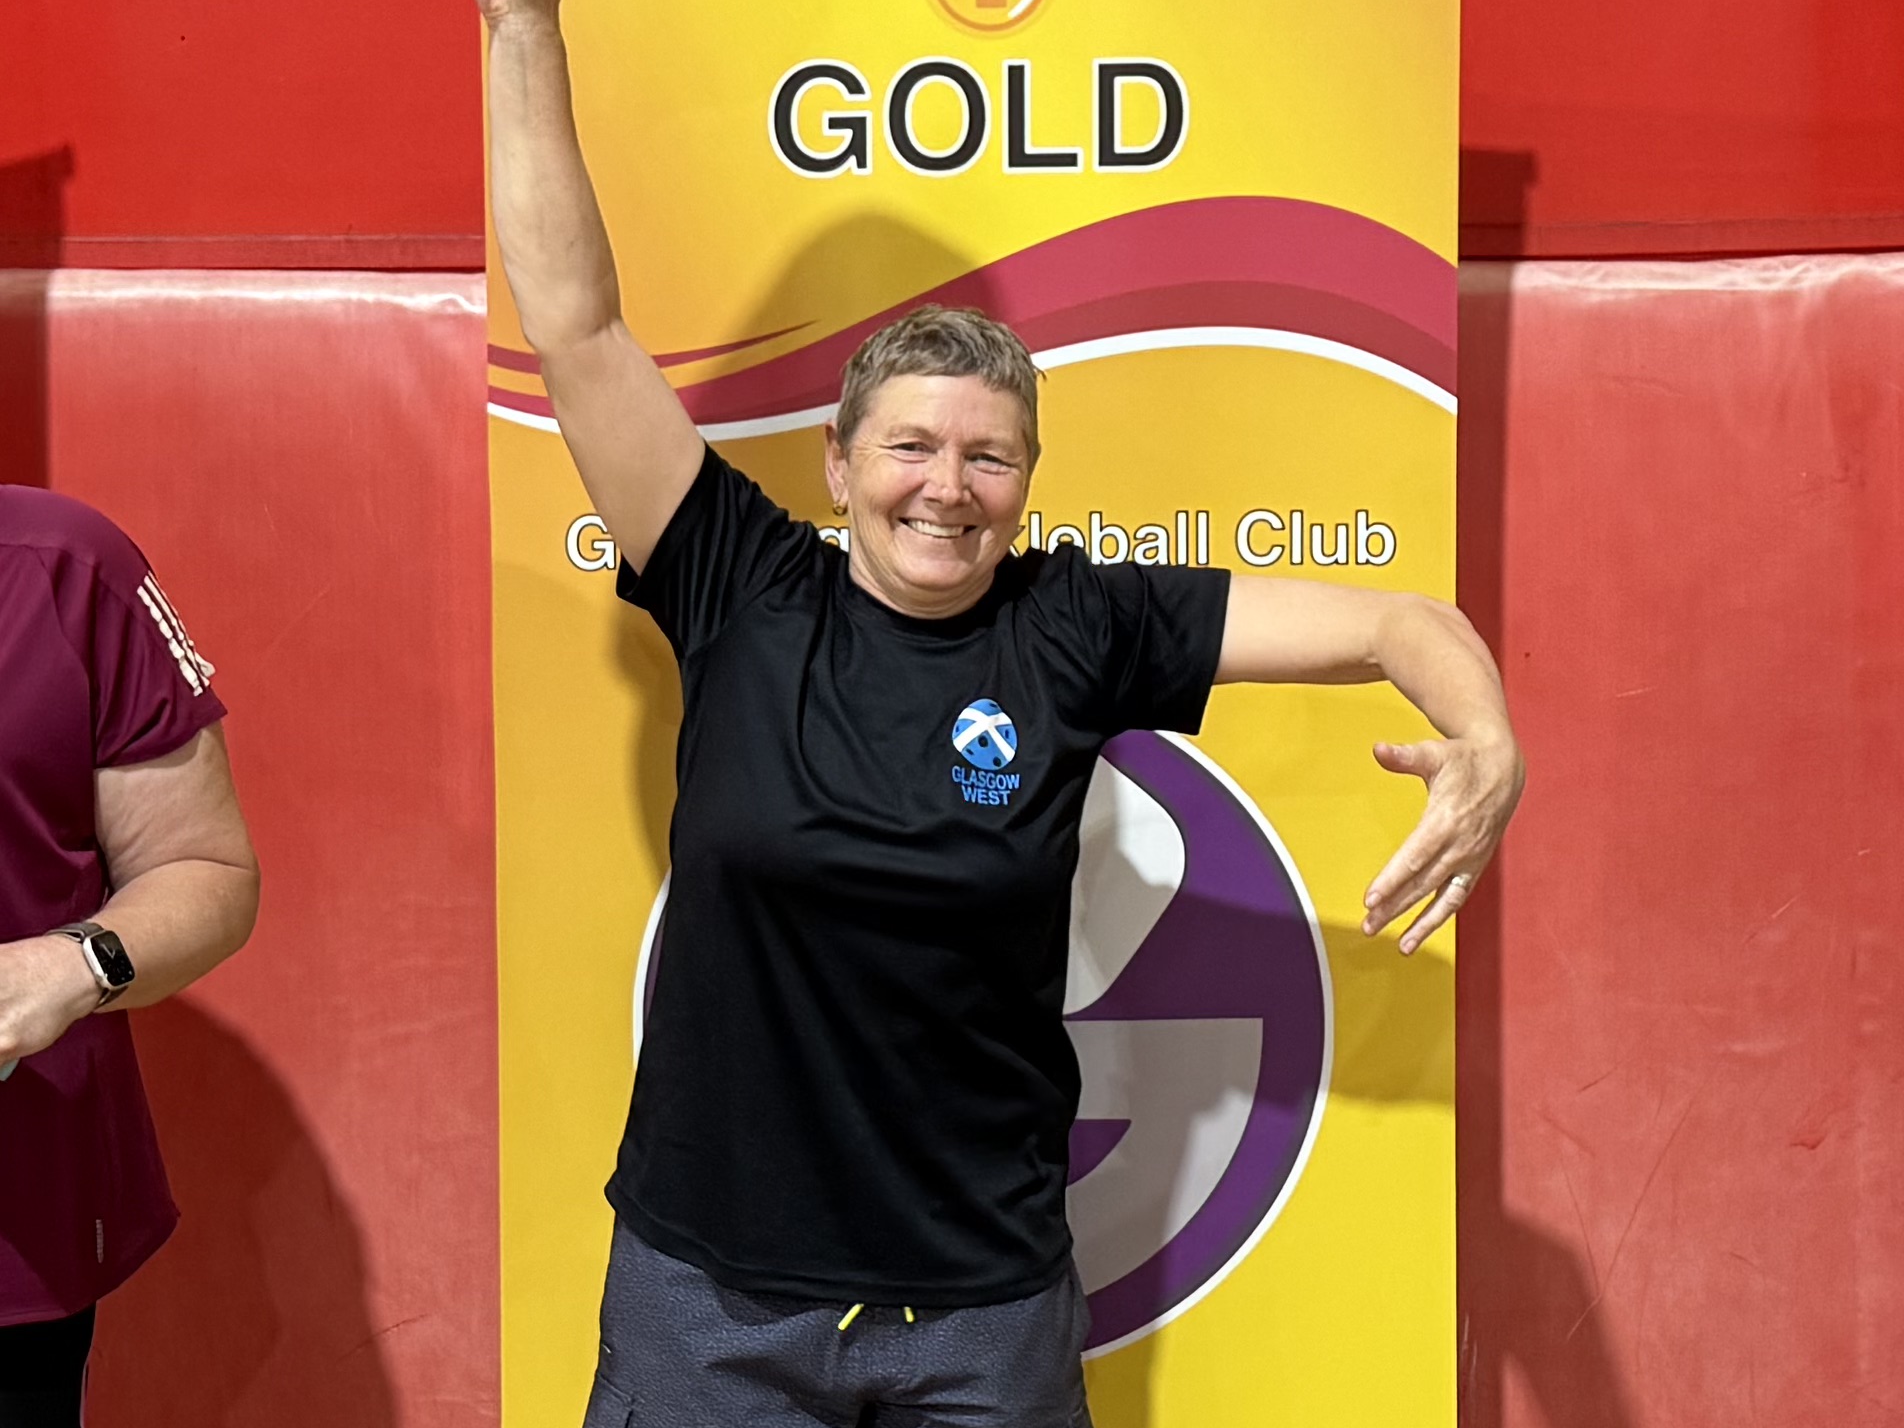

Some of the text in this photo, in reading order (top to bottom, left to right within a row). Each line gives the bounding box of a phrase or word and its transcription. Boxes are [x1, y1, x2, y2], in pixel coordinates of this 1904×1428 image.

[773, 60, 1184, 172] GOLD
[1235, 508, 1398, 567] Club
[951, 765, 1020, 790] GLASGOW
[961, 785, 1011, 806] WEST
